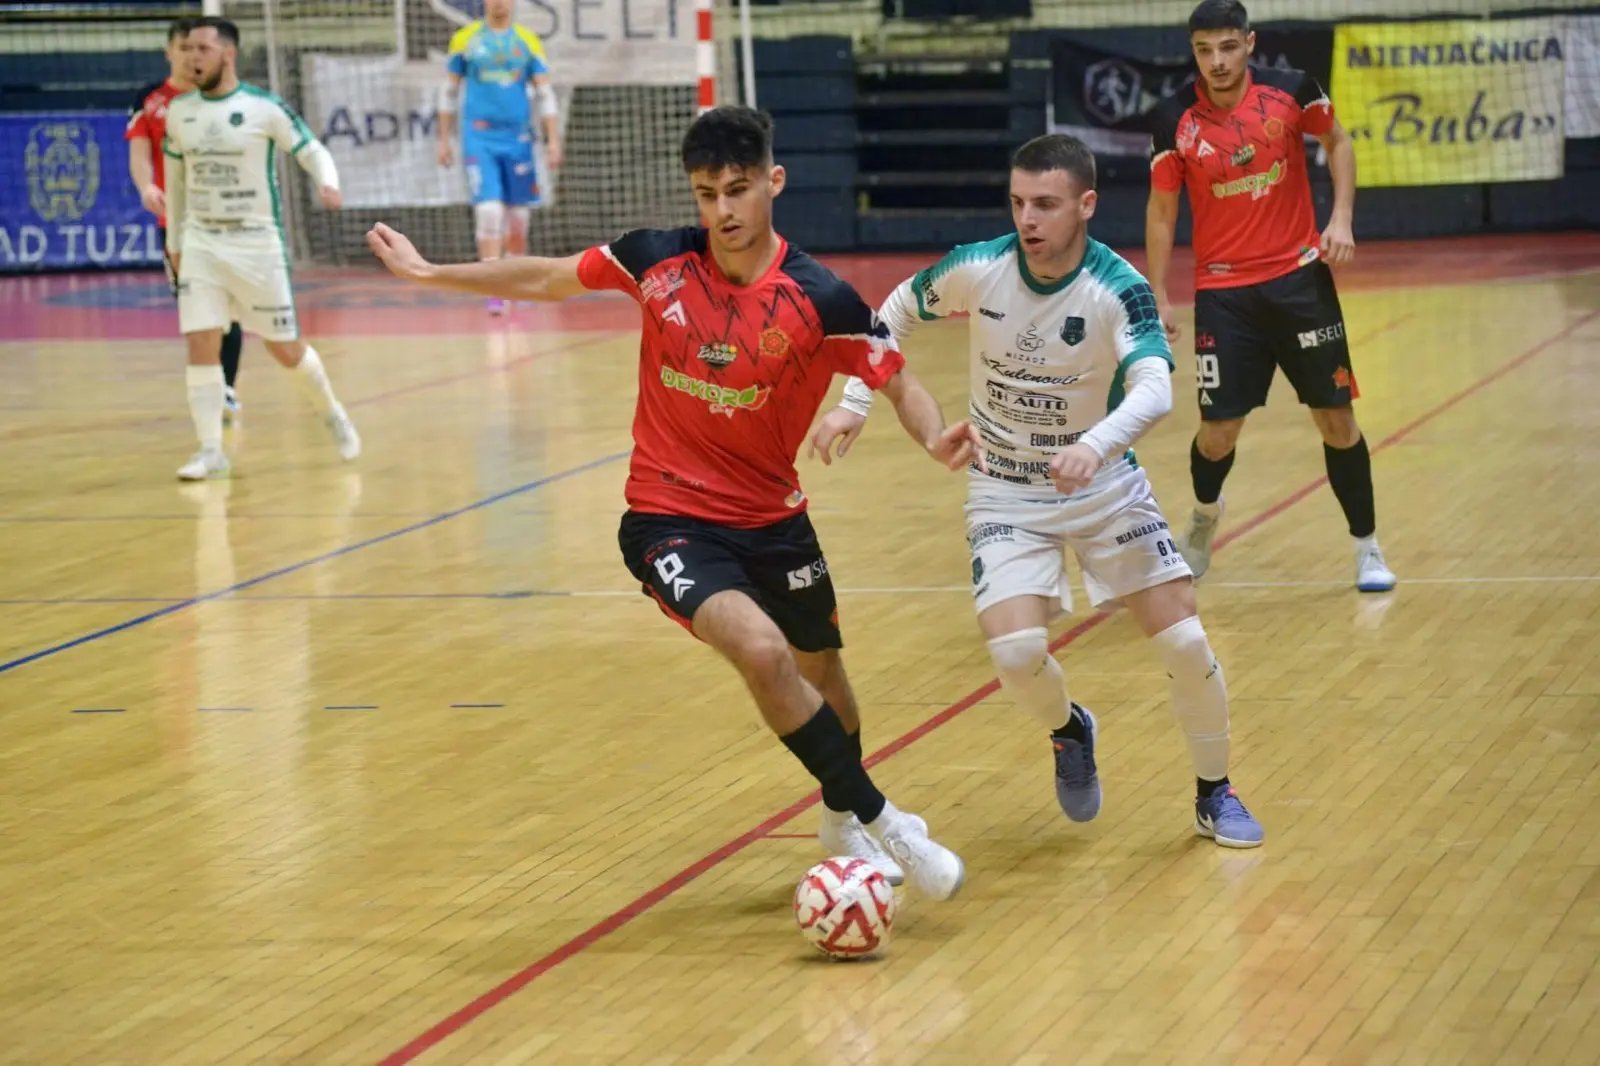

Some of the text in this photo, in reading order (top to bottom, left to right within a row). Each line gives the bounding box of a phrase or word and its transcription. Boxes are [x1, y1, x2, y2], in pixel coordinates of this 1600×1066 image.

[1347, 33, 1563, 70] MJENJAČNICA
[1013, 396, 1069, 411] AUTO
[1030, 432, 1056, 447] EURO
